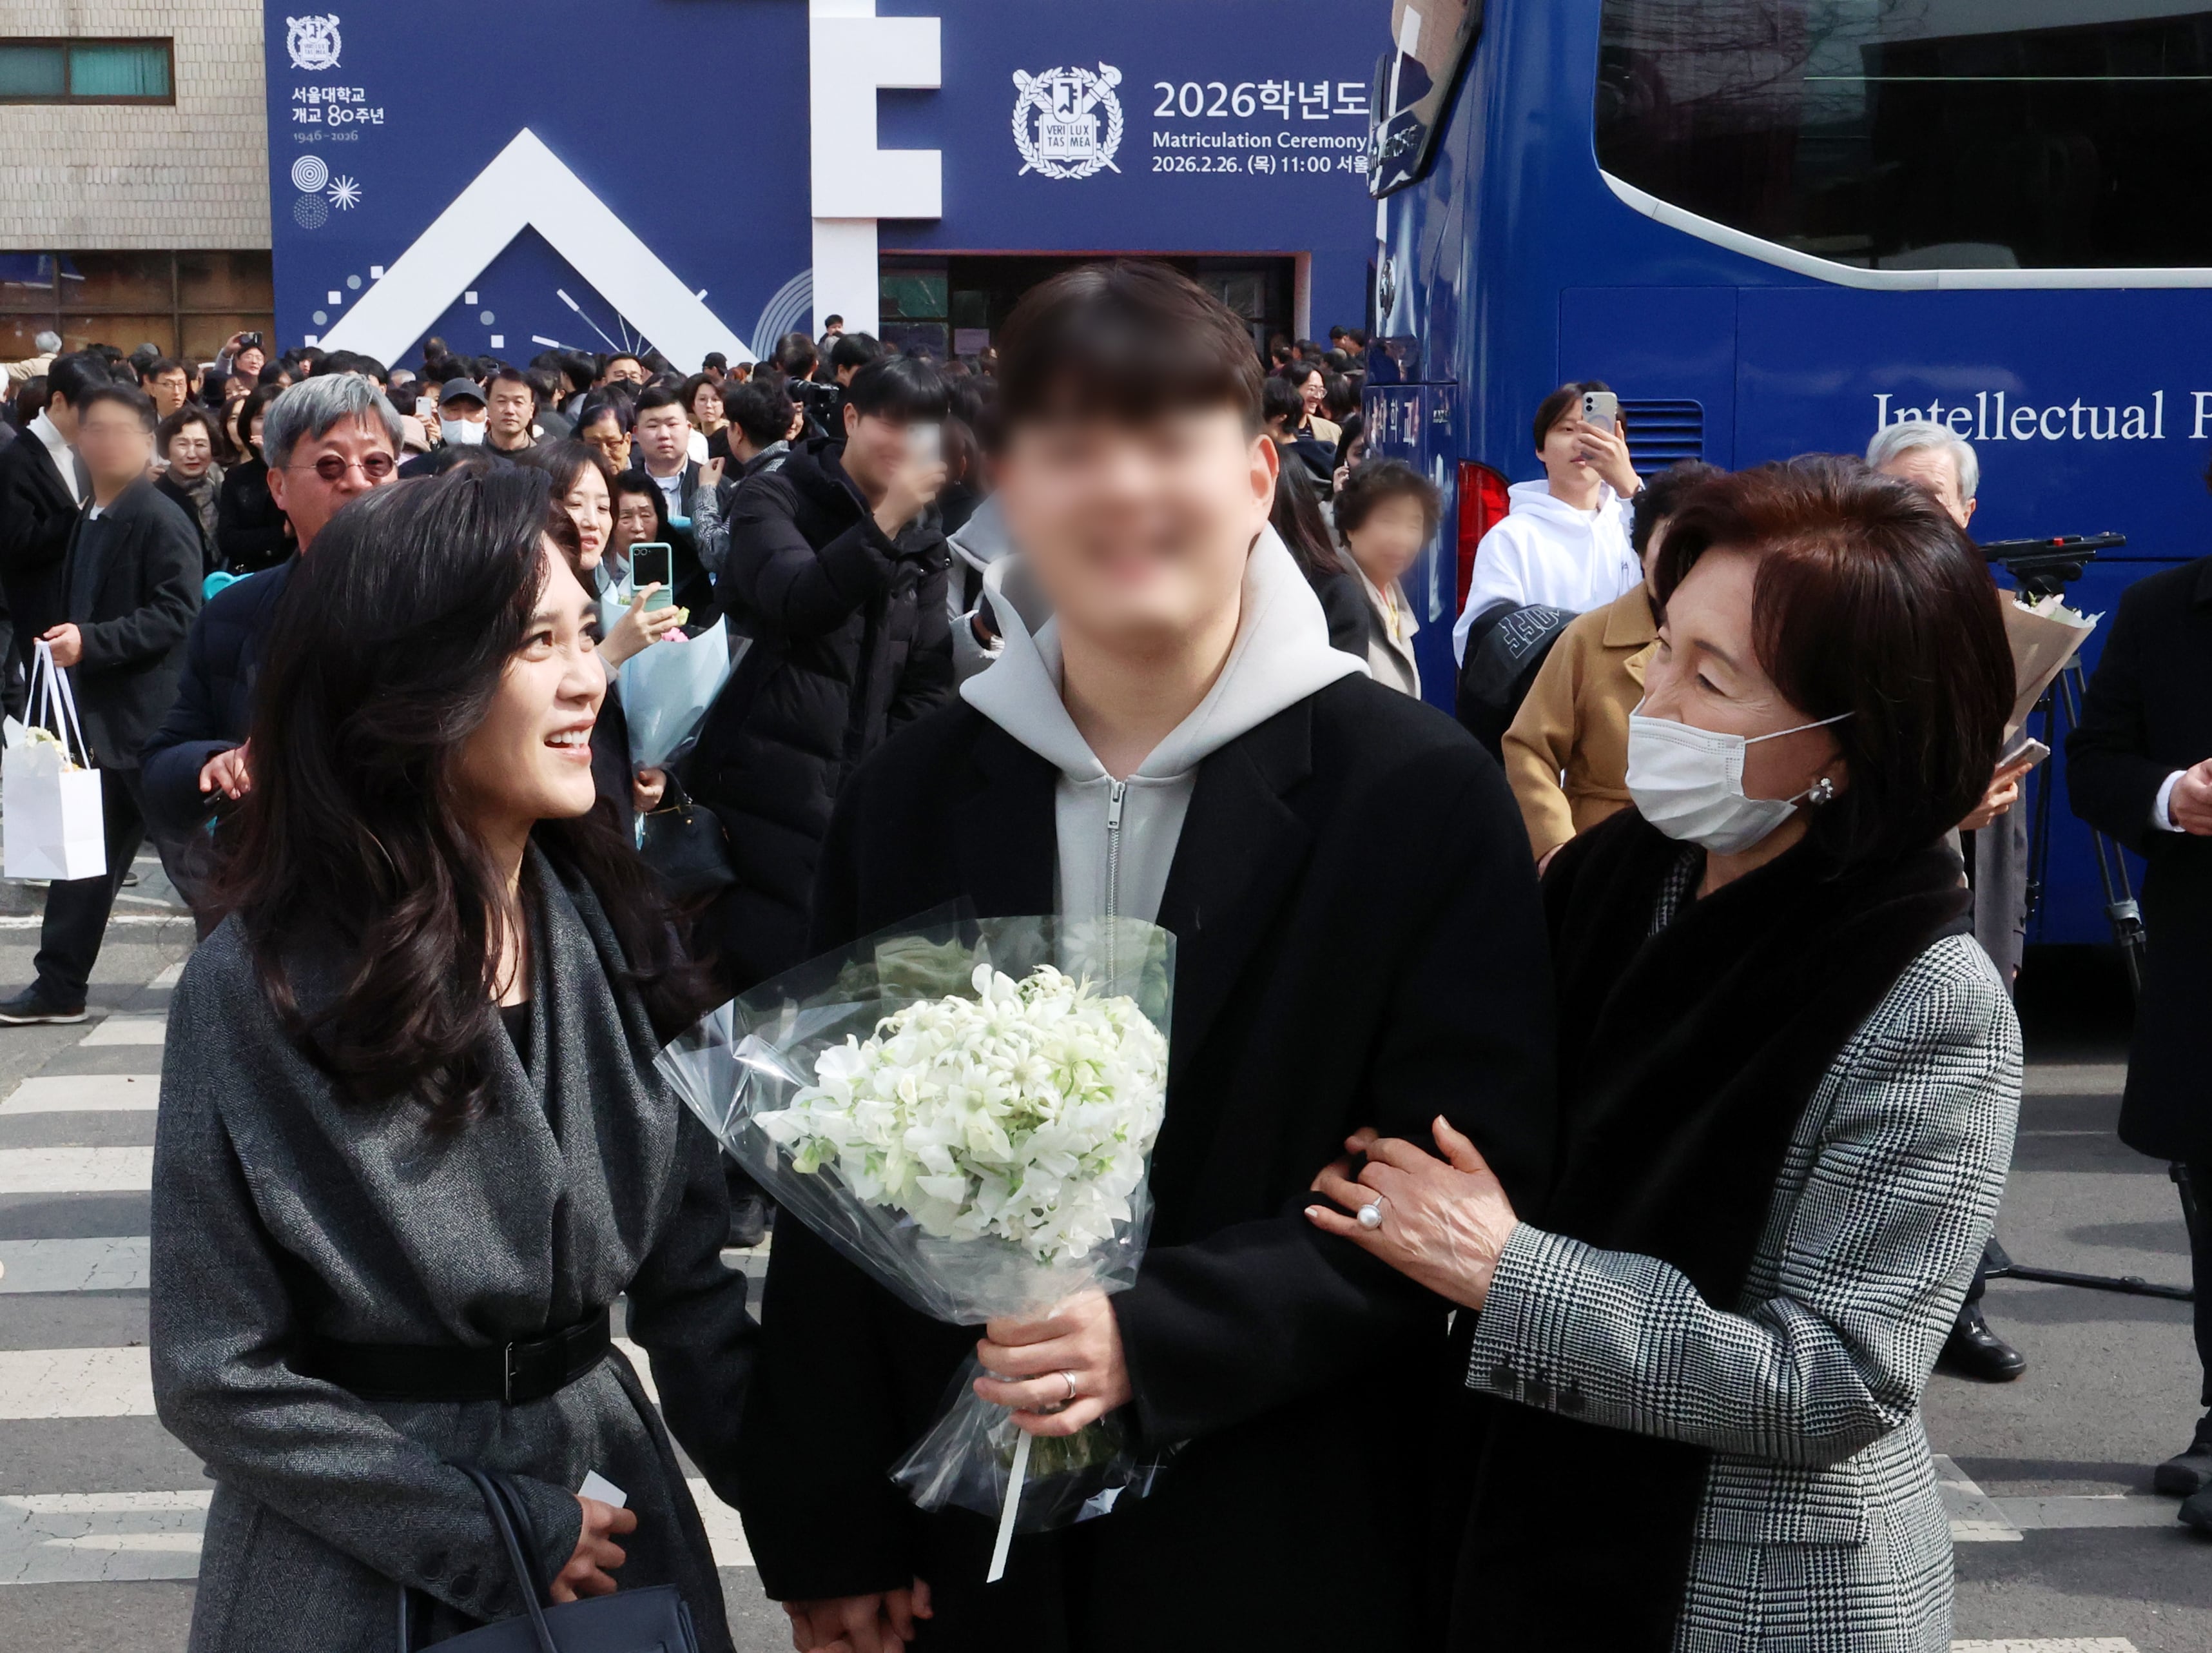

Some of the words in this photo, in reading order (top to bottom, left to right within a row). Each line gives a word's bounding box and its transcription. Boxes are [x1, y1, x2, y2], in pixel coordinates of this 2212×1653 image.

[292, 86, 365, 104] 서울대학교
[1153, 79, 1370, 121] 2026학년도
[293, 107, 322, 124] 개교
[327, 104, 384, 126] 80주년
[1047, 125, 1065, 135] VERI
[1071, 125, 1089, 135] LUX
[1048, 137, 1065, 146] TAS
[1070, 137, 1091, 146] MEA
[1152, 131, 1272, 148] Matriculation
[1277, 132, 1367, 153] Ceremony
[1152, 155, 1243, 173] 2026.2.26.
[1247, 155, 1276, 175] (목)
[1281, 156, 1331, 173] 11:00
